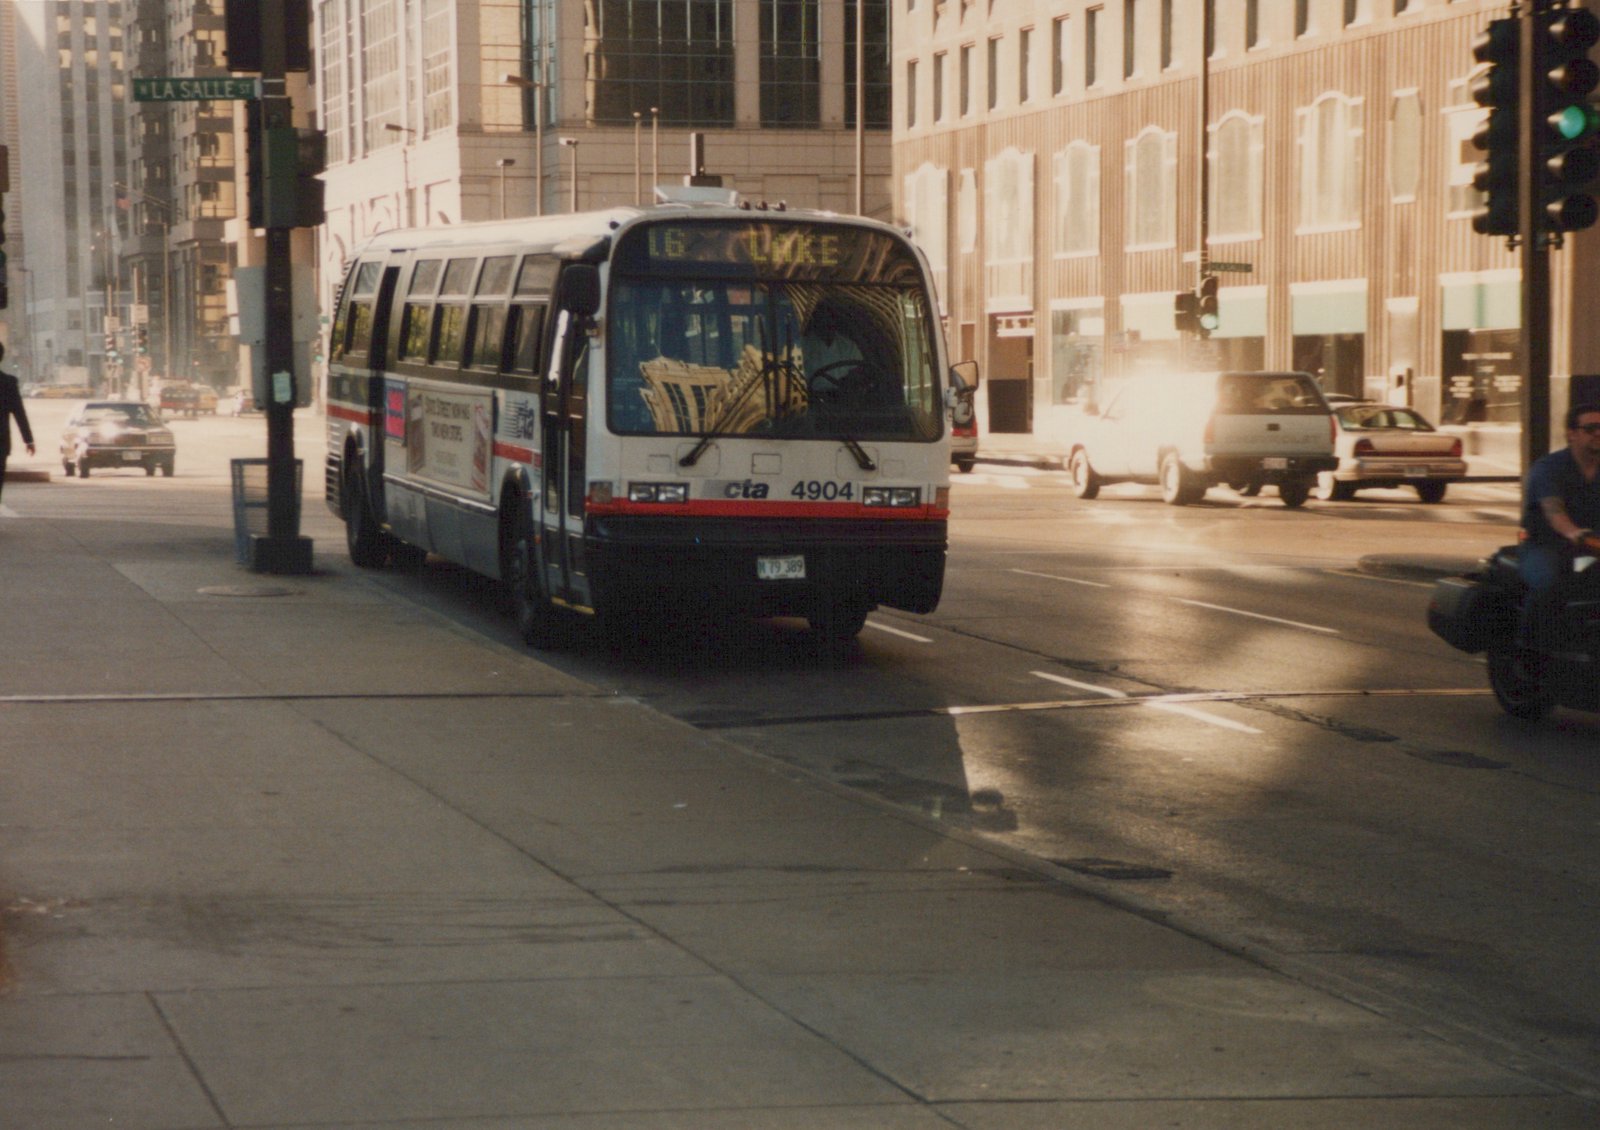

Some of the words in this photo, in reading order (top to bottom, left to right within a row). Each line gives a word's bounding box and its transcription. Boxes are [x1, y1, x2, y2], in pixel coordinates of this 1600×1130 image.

[152, 81, 175, 99] LA
[180, 80, 235, 98] SALLE
[239, 84, 250, 95] ST
[648, 228, 686, 258] 16
[750, 231, 838, 264] LAKE
[724, 479, 769, 499] cta
[791, 481, 853, 501] 4904
